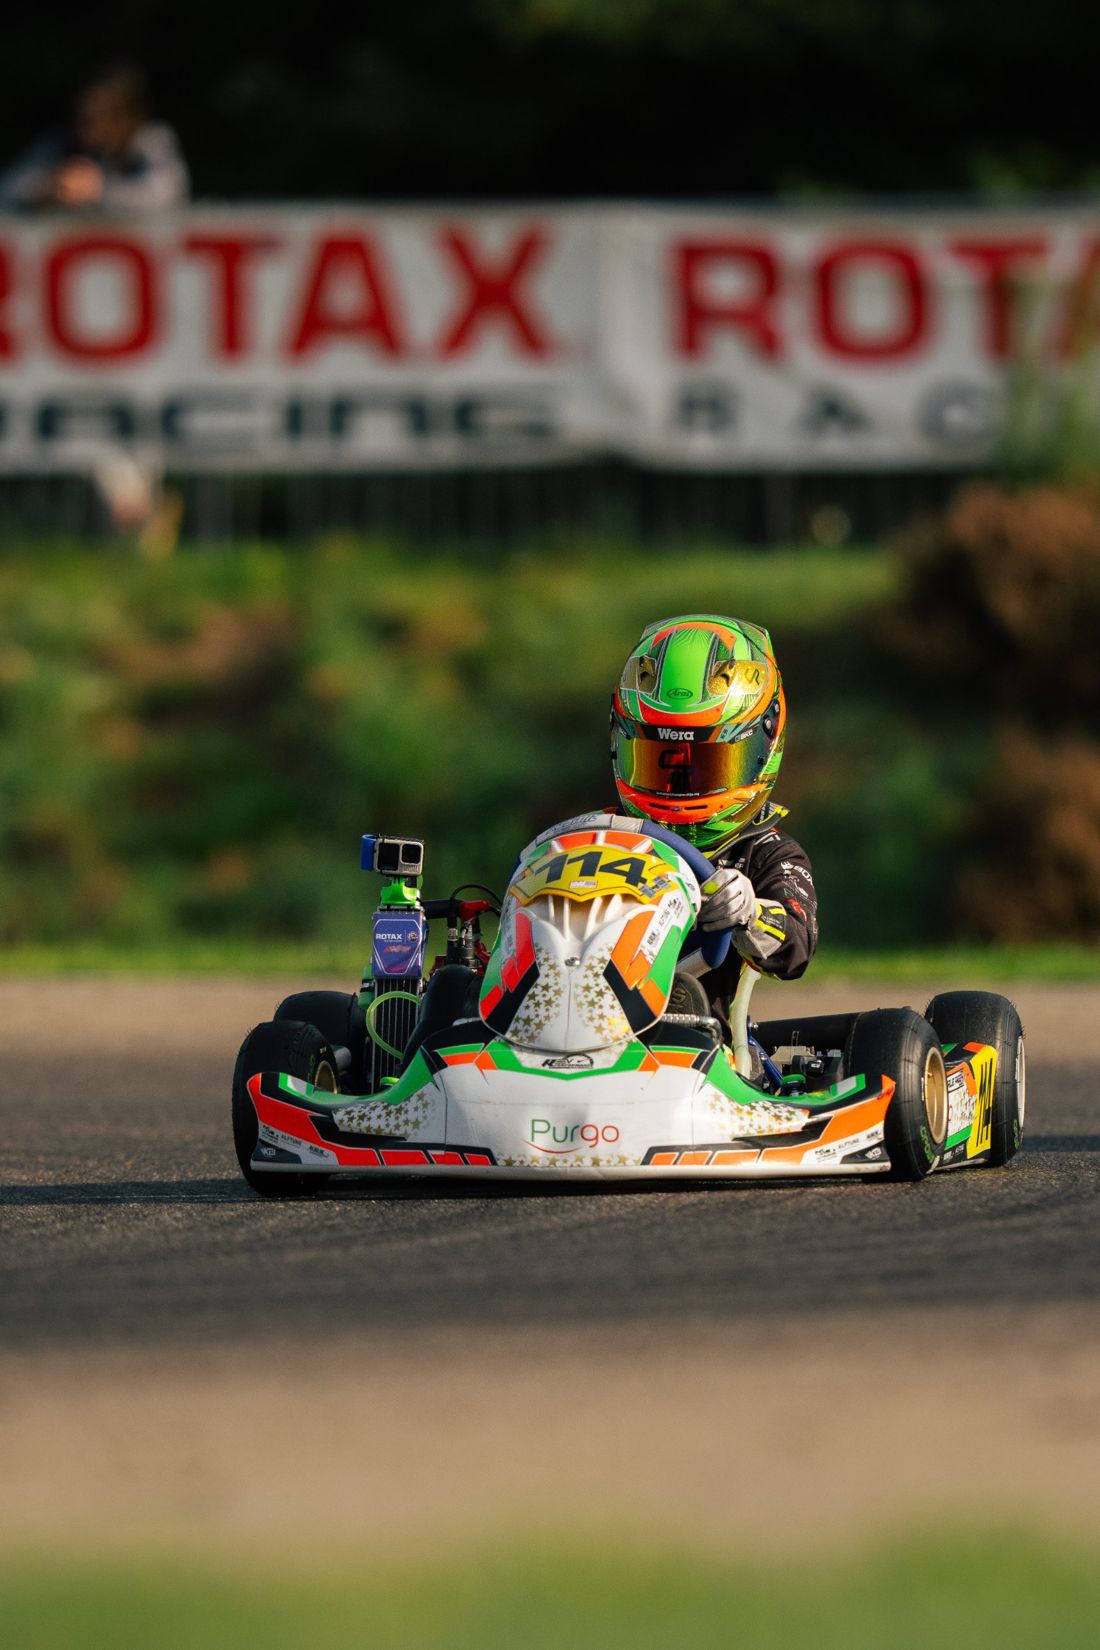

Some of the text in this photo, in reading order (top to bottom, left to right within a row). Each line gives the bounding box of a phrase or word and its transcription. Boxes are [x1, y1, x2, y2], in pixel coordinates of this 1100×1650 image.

[0, 226, 556, 366] OTAX
[657, 727, 695, 741] Wera
[535, 851, 648, 887] 114
[531, 1119, 620, 1148] Purgo
